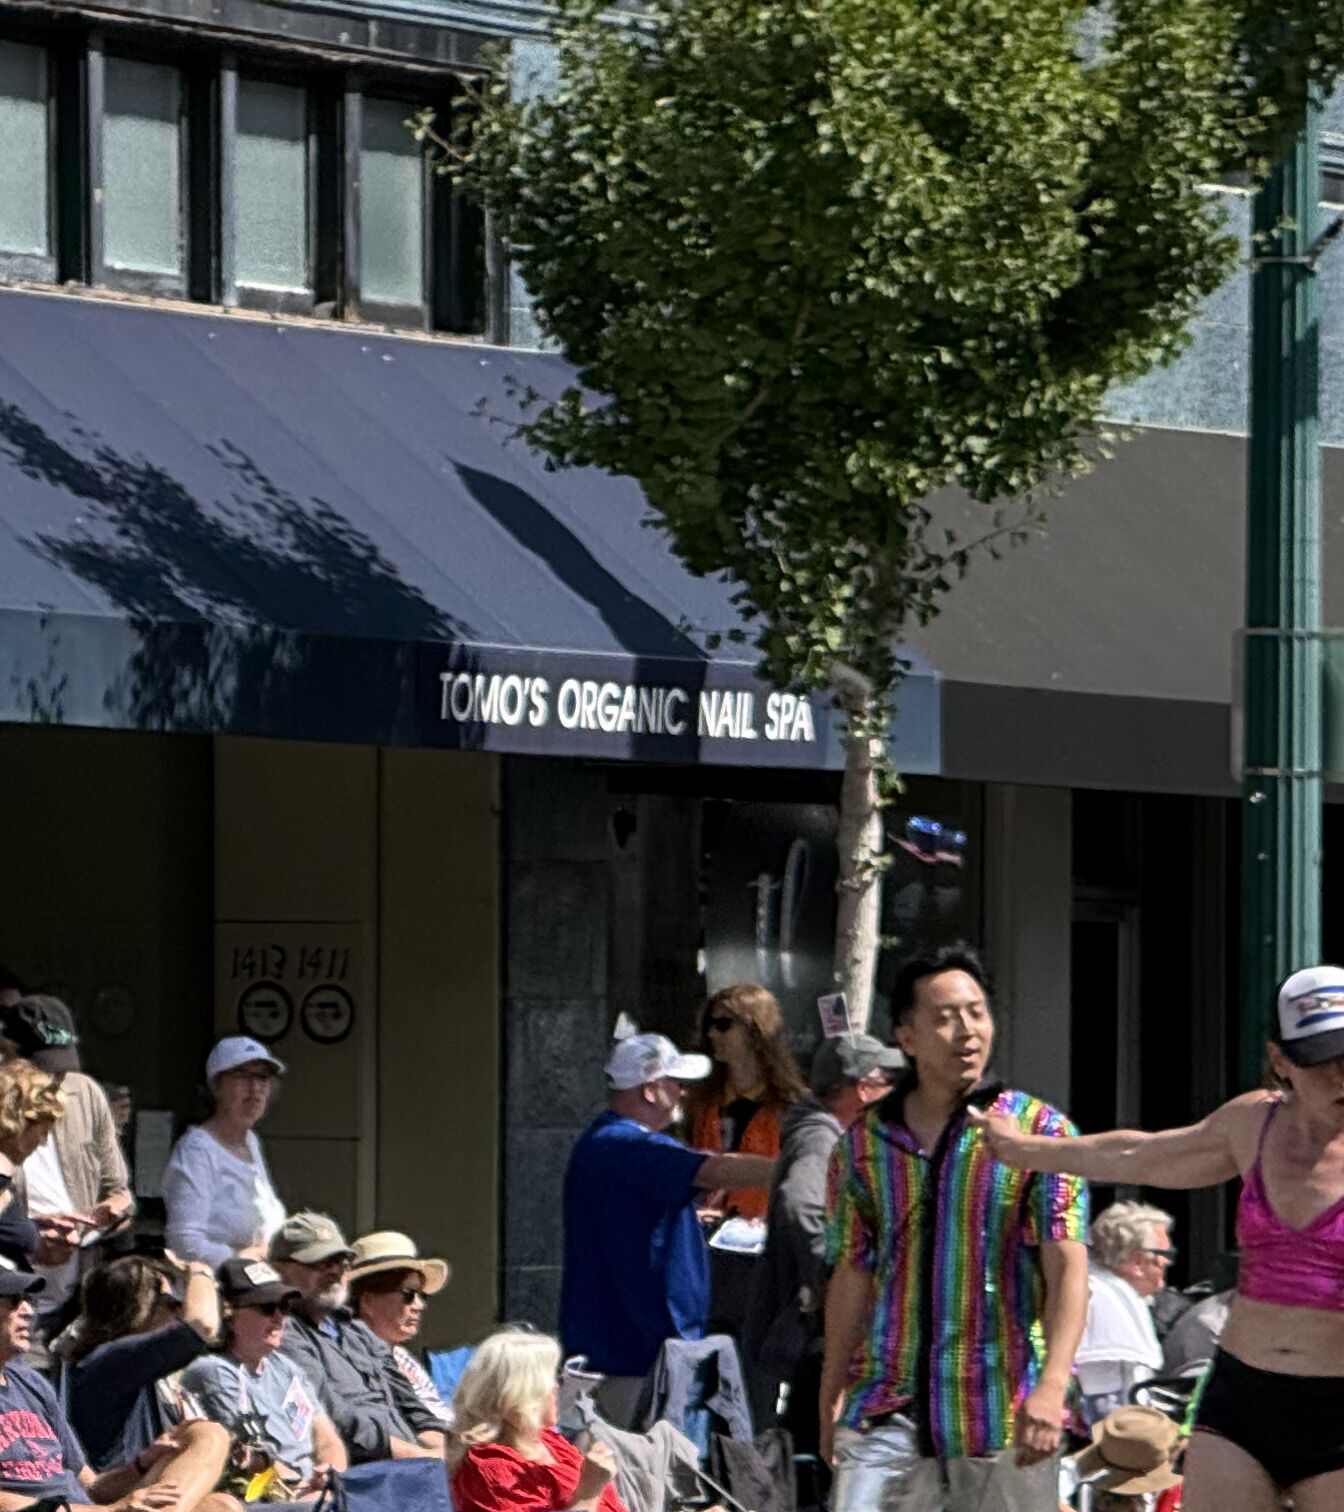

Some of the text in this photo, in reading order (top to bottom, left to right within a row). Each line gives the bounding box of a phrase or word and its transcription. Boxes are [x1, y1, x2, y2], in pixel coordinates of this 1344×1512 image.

[439, 672, 816, 742] TOMO'S ORGANIC NAIL SPA
[231, 944, 350, 980] 1413 1411
